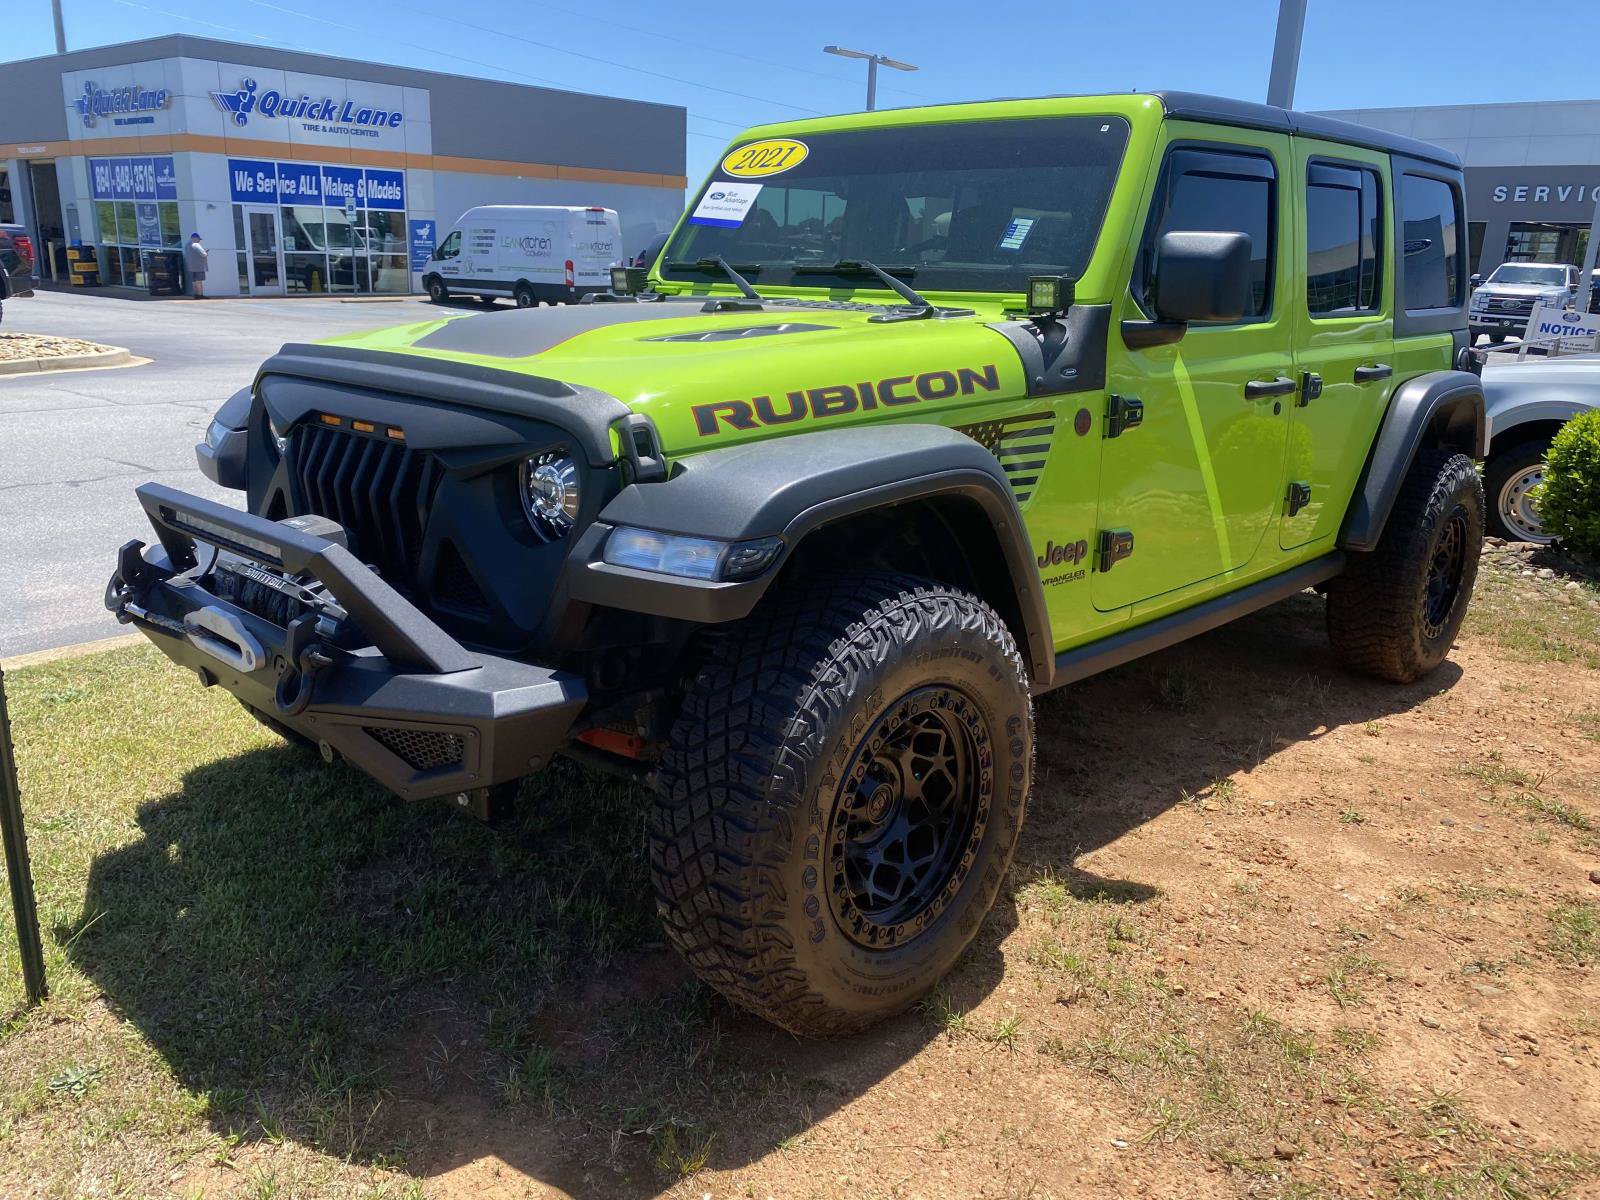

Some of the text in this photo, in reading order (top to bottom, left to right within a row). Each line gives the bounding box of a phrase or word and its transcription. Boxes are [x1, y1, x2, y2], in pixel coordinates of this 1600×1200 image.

[130, 86, 166, 112] Lane
[259, 90, 403, 128] Quick Lane
[302, 123, 320, 132] TIRE
[328, 126, 349, 135] AUTO
[350, 128, 379, 138] CENTER
[732, 146, 797, 170] 2021
[234, 170, 401, 200] We Service ALL Makes & Models
[1540, 322, 1597, 336] NOTICE
[691, 364, 1000, 437] RUBICON
[1037, 539, 1088, 568] Jeep
[244, 567, 288, 590] SMITTYBILT
[802, 686, 884, 945] GOODYEAR
